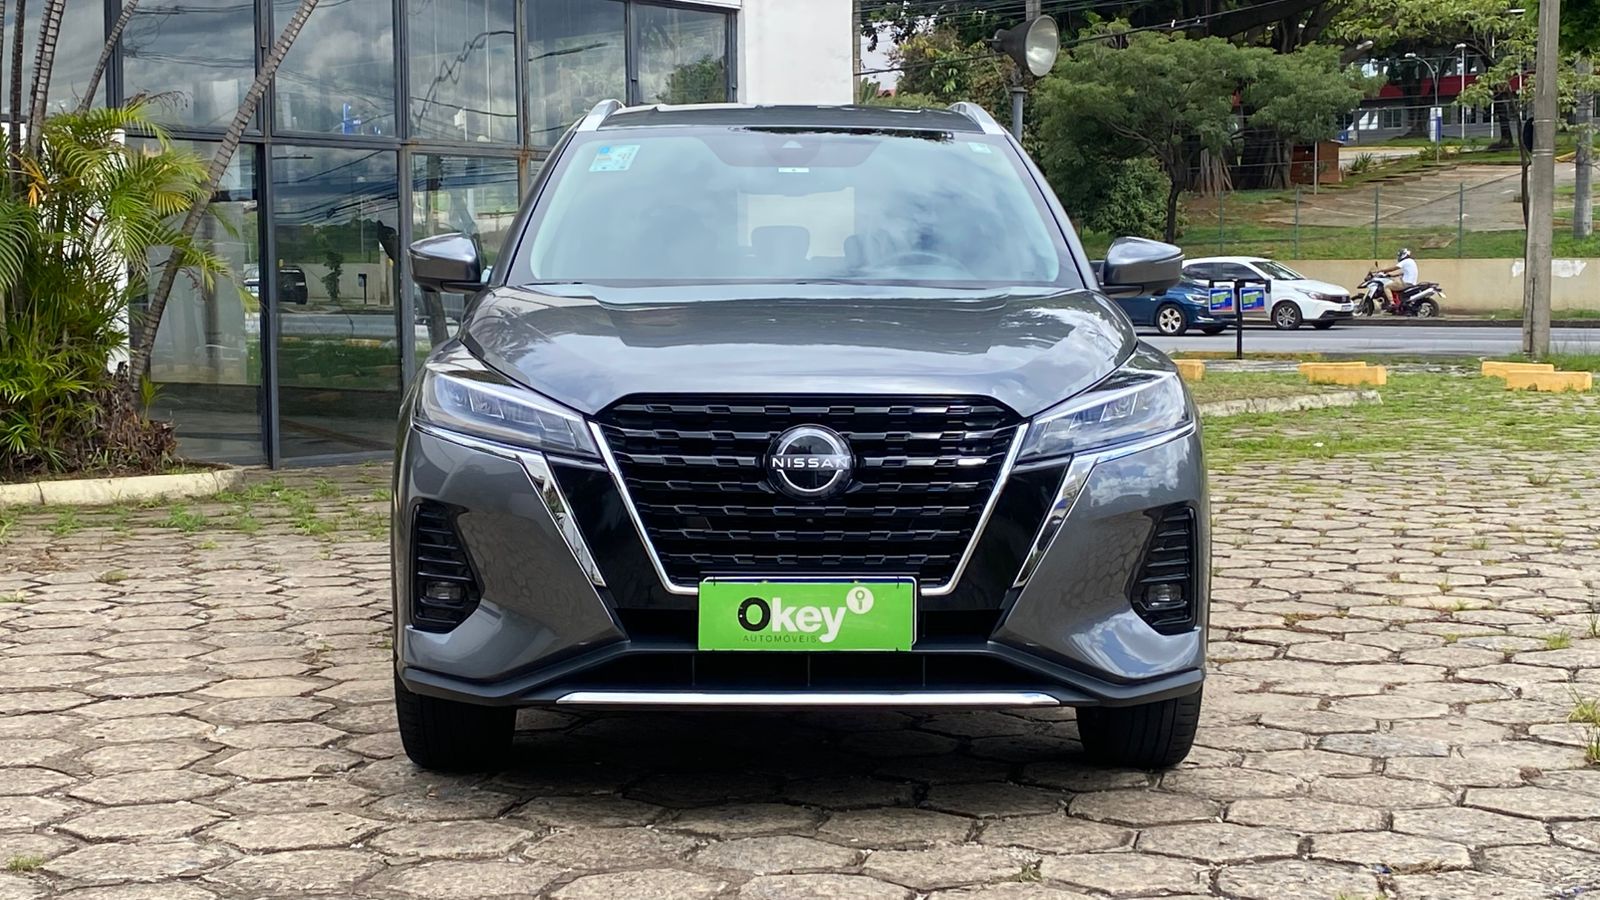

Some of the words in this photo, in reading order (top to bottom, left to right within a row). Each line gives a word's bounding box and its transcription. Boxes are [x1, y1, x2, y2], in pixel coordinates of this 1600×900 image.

[772, 457, 849, 468] NISSAN
[737, 597, 847, 643] Okey
[743, 633, 818, 643] AUTOMÓVEIS
